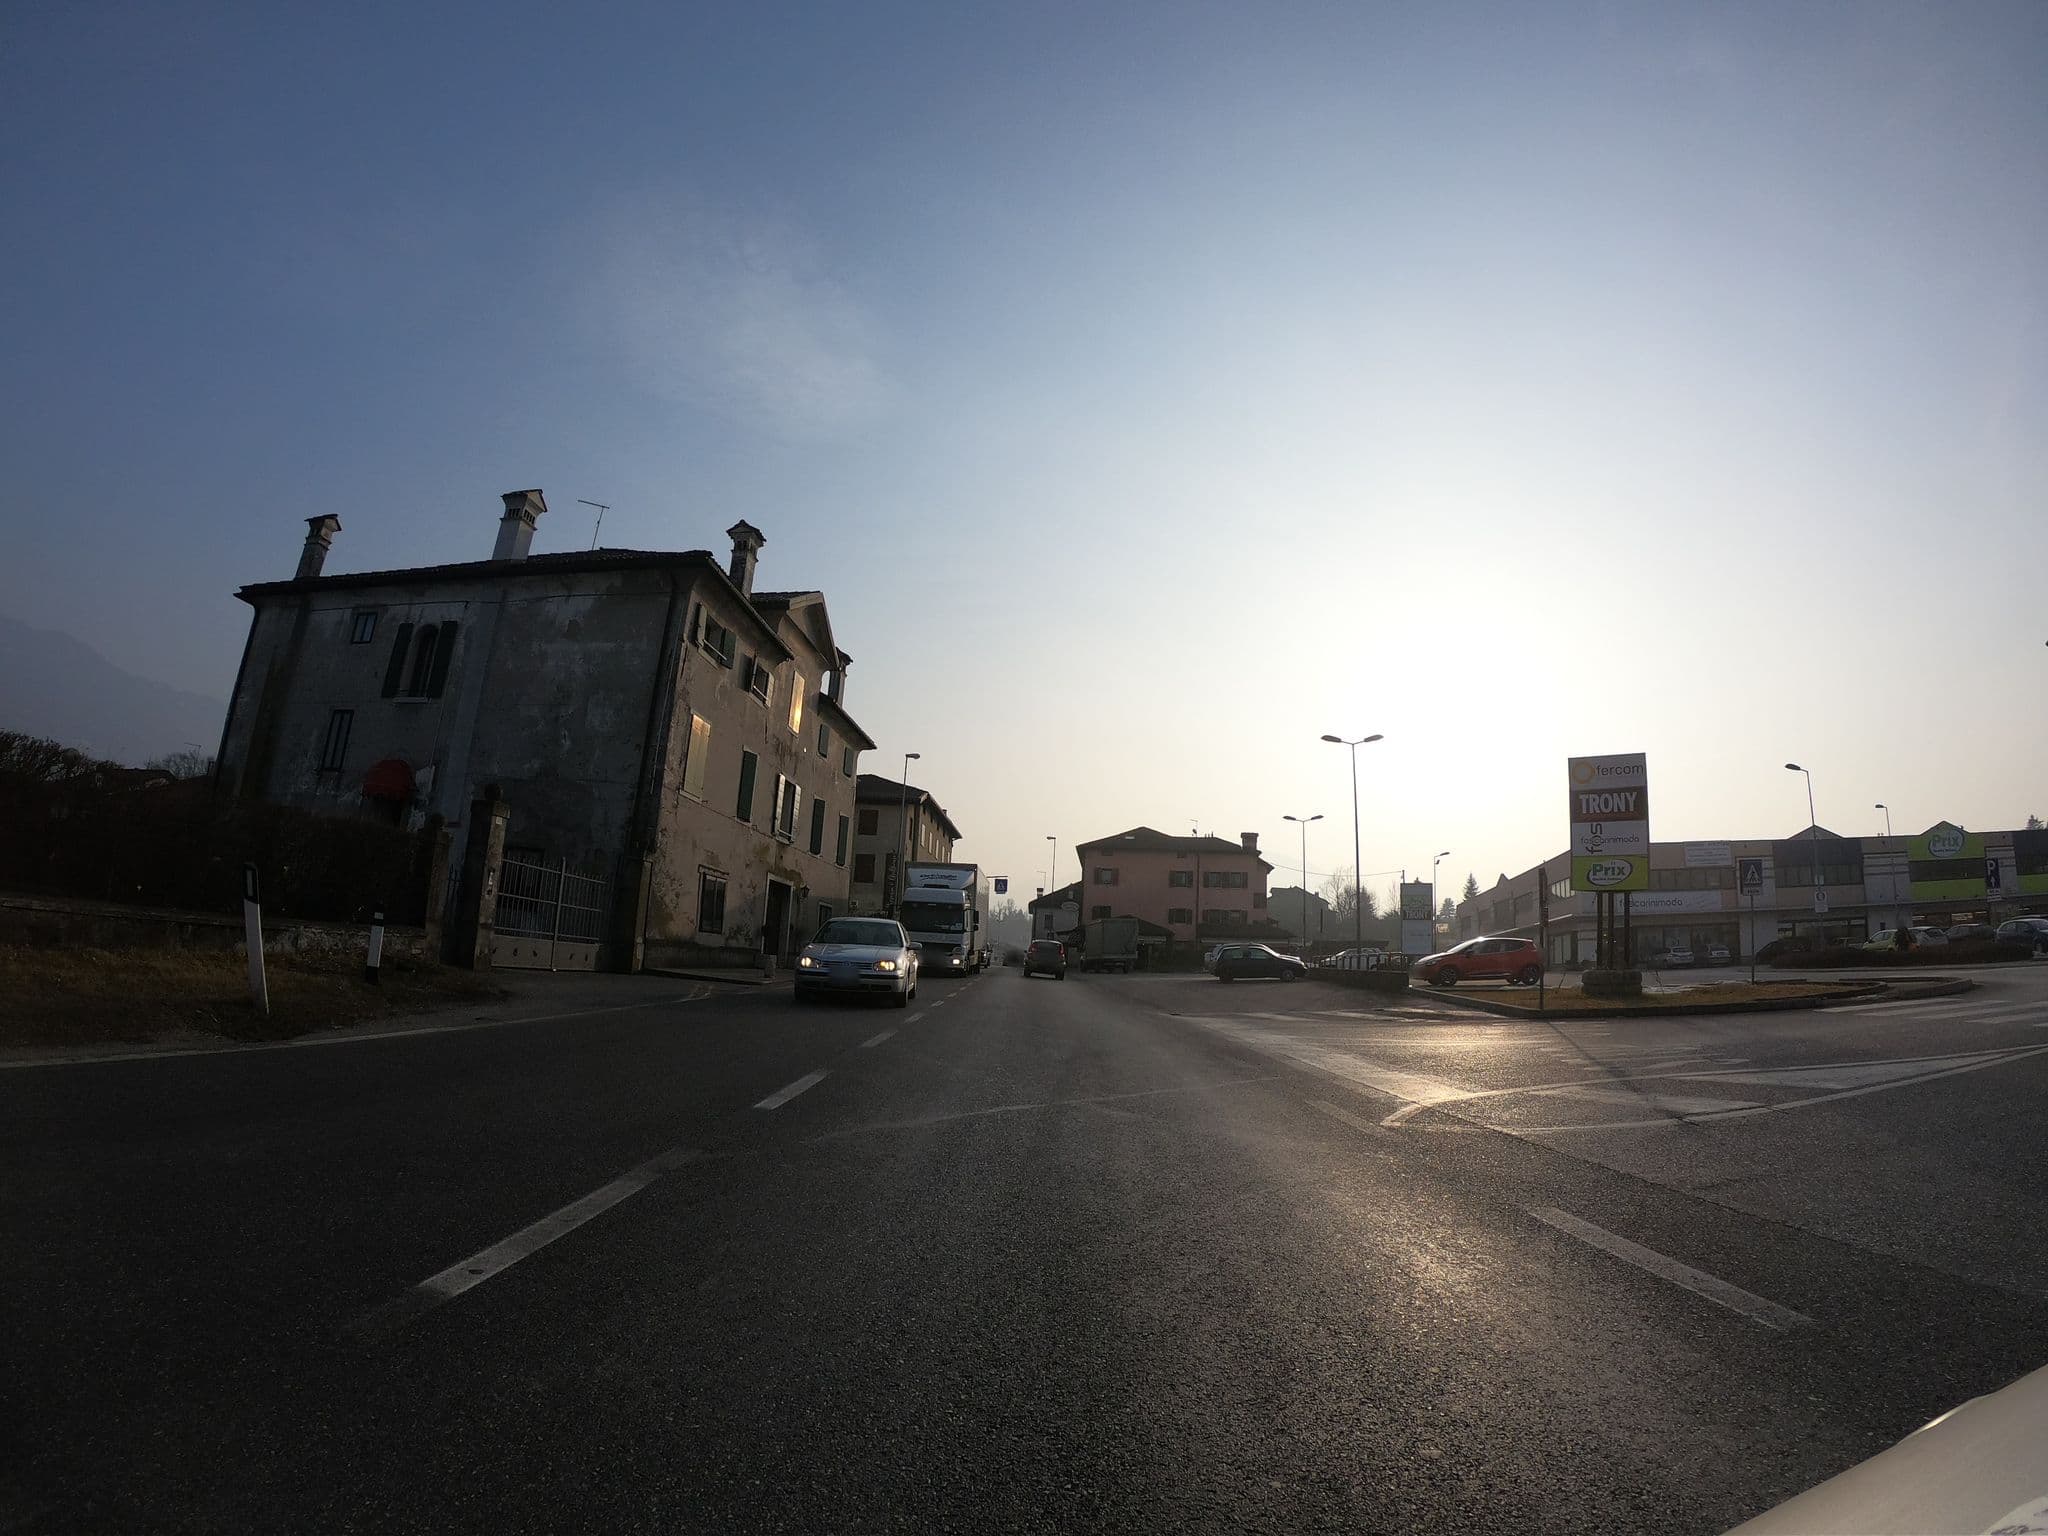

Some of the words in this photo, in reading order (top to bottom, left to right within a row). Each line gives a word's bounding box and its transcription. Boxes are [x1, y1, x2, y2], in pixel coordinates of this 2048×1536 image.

[1596, 764, 1644, 776] fercom
[1579, 792, 1638, 814] TRONY
[1592, 861, 1626, 876] Prix
[1986, 859, 1996, 876] P
